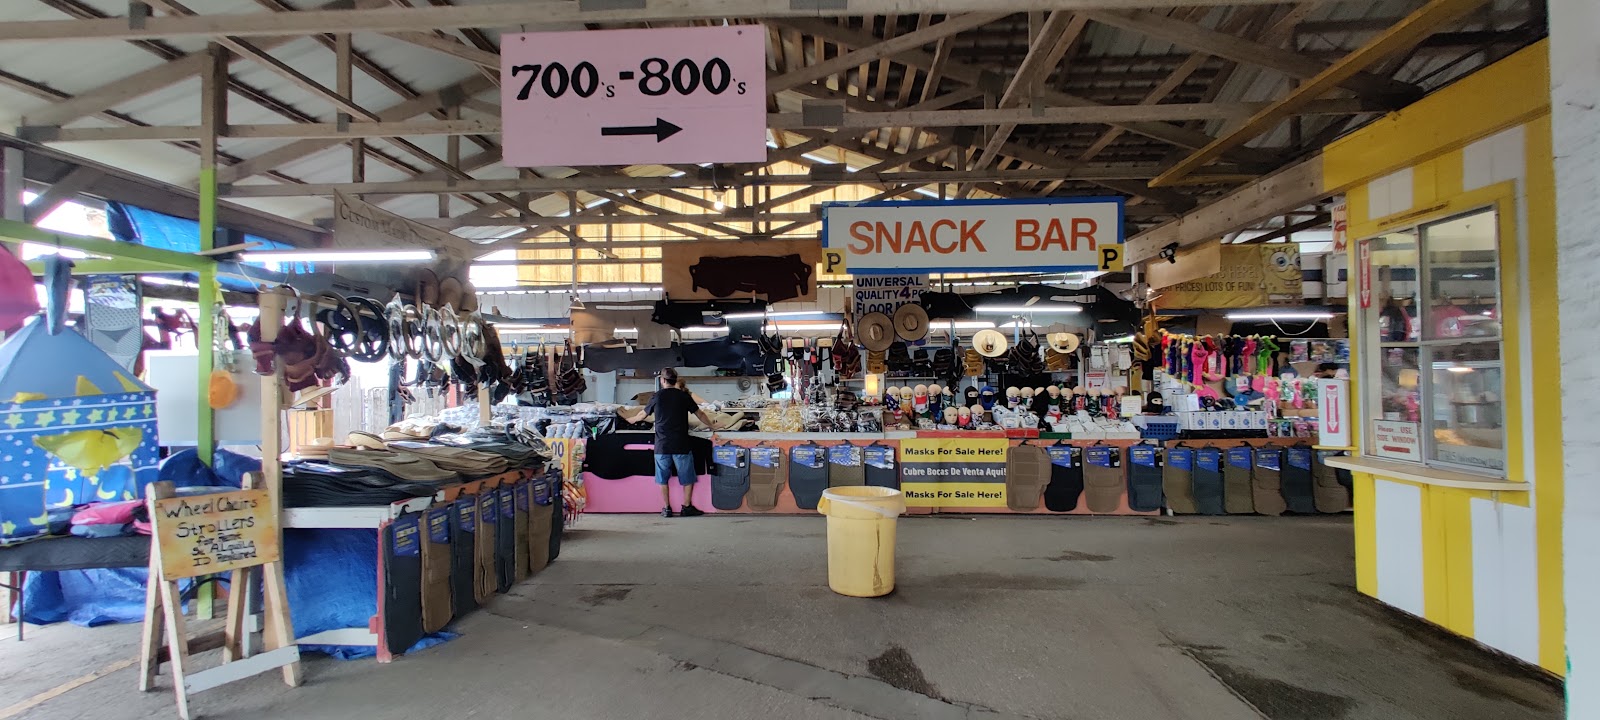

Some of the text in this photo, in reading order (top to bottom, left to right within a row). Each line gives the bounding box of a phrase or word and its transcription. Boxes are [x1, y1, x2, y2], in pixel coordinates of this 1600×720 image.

[847, 217, 1097, 255] SNACK BAR
[826, 252, 842, 273] P
[1102, 248, 1118, 270] P
[856, 276, 923, 287] UNIVERSAL
[1205, 281, 1223, 292] LOTS
[1225, 281, 1237, 292] OF
[855, 289, 900, 302] QUALITY
[899, 286, 911, 299] 4
[856, 301, 893, 316] FLOOR
[1400, 426, 1413, 435] USE
[905, 447, 1003, 456] Masks For Sale Here!
[902, 467, 926, 476] Cubre
[926, 467, 949, 476] Bocas
[950, 467, 961, 476] De
[962, 467, 984, 476] Venta
[905, 490, 1002, 499] Masks For Sale Here!
